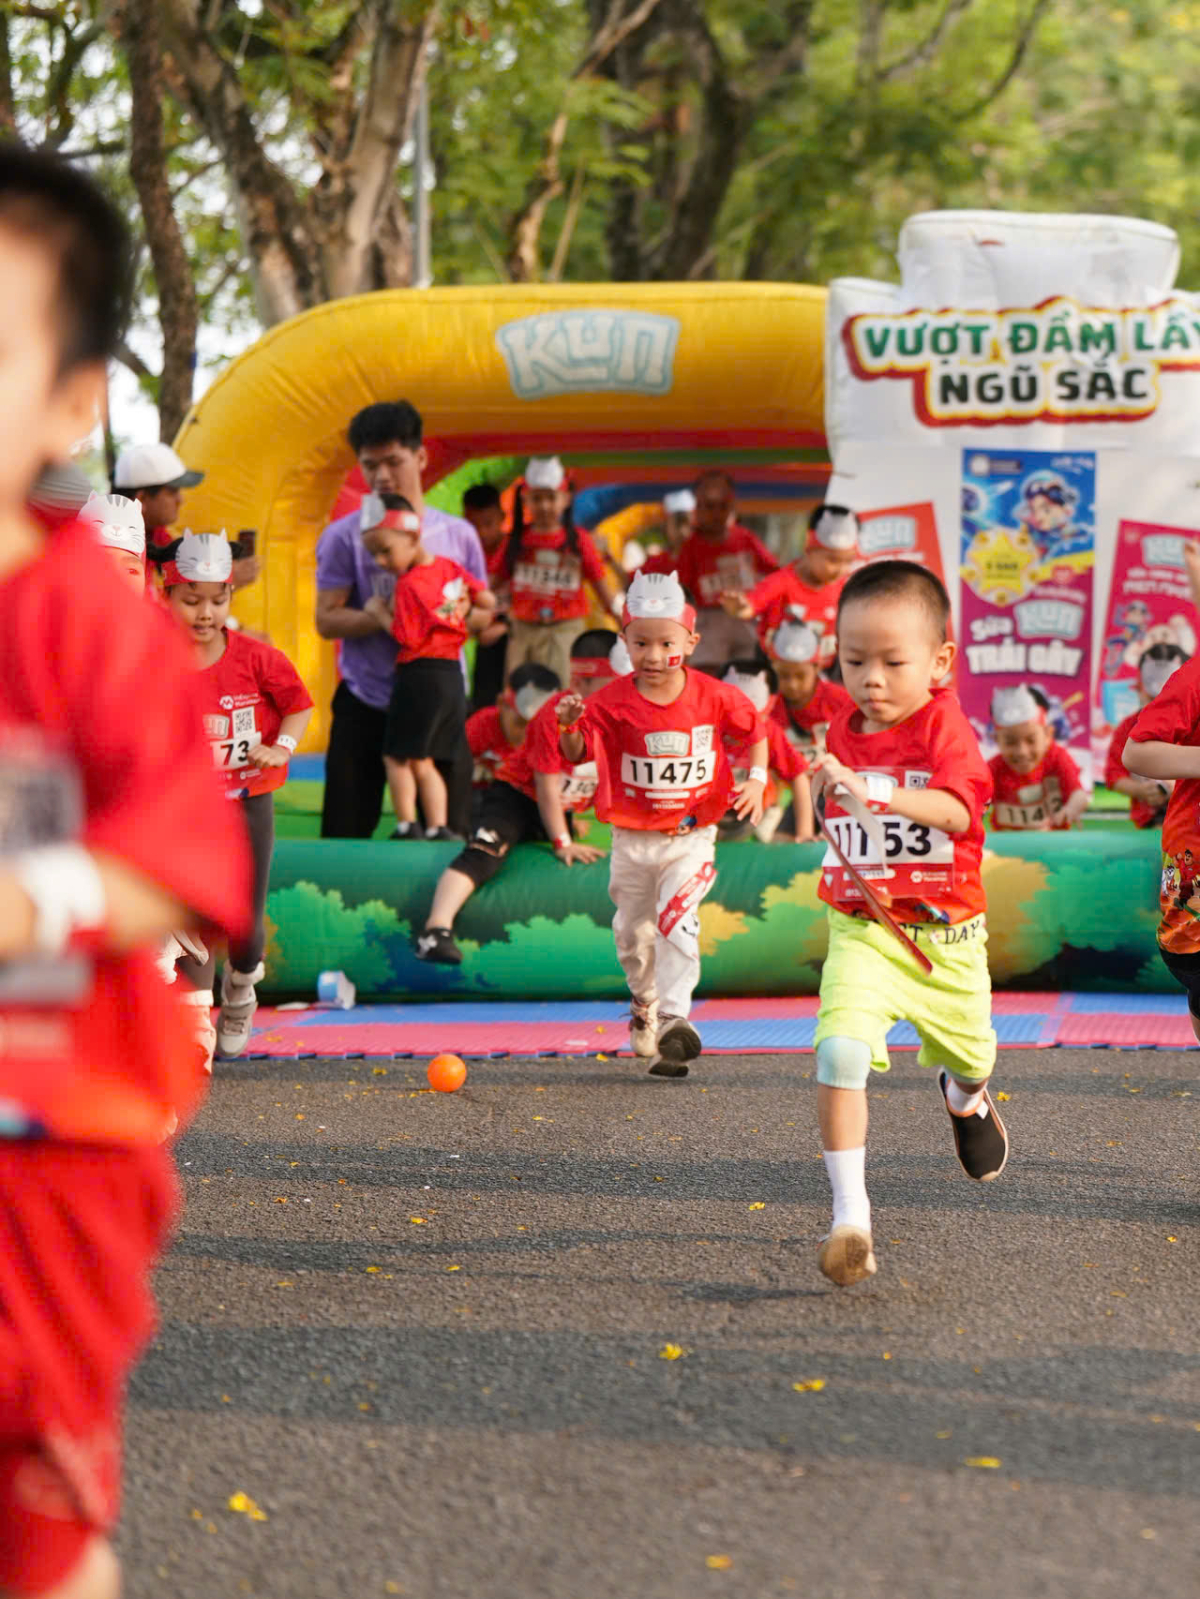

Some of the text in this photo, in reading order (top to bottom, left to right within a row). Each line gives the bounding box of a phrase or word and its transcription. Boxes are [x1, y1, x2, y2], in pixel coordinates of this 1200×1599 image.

[864, 320, 991, 364] VƯỢT
[939, 365, 1038, 404] NGŨ
[630, 759, 707, 784] 11475
[944, 920, 980, 945] DAY
